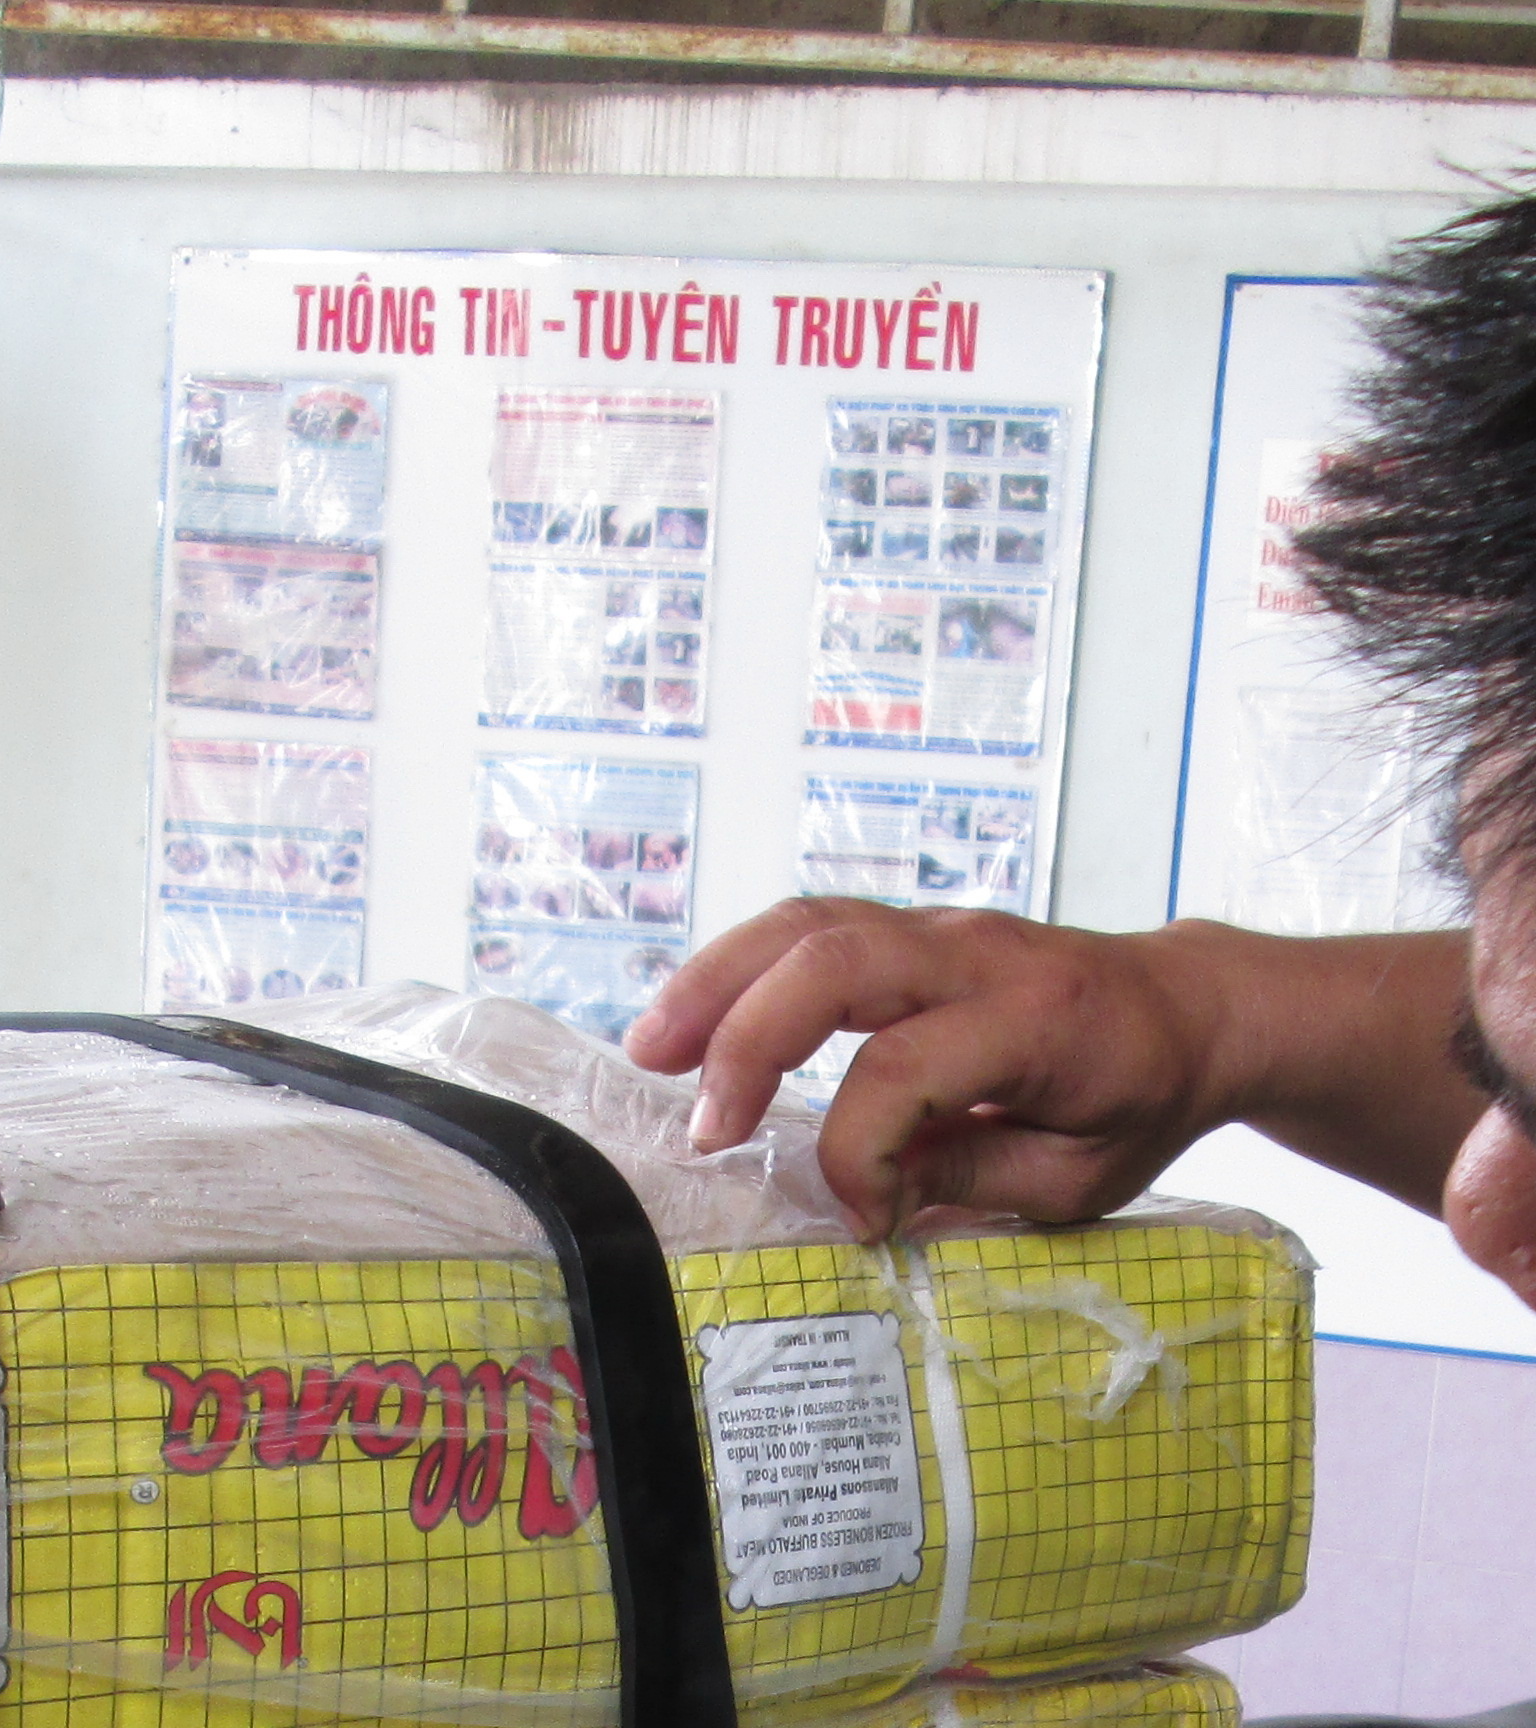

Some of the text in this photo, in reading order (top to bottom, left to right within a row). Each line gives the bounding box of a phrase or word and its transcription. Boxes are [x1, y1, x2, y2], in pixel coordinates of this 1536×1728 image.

[293, 271, 436, 357] THÔNG
[460, 287, 530, 358] TIN
[572, 280, 740, 365] TUYÊN
[772, 281, 981, 373] TRUYỀN
[725, 1444, 758, 1464] India
[744, 1467, 777, 1486] Road
[780, 1462, 818, 1481] Allana
[740, 1489, 789, 1511] Limited
[781, 1506, 872, 1529] PRODUCE OF INDIA
[819, 1523, 874, 1549] BONELESS
[874, 1519, 912, 1541] FROZEN
[767, 1532, 817, 1555] BUFFALO
[771, 1564, 829, 1586] DEGLANDED
